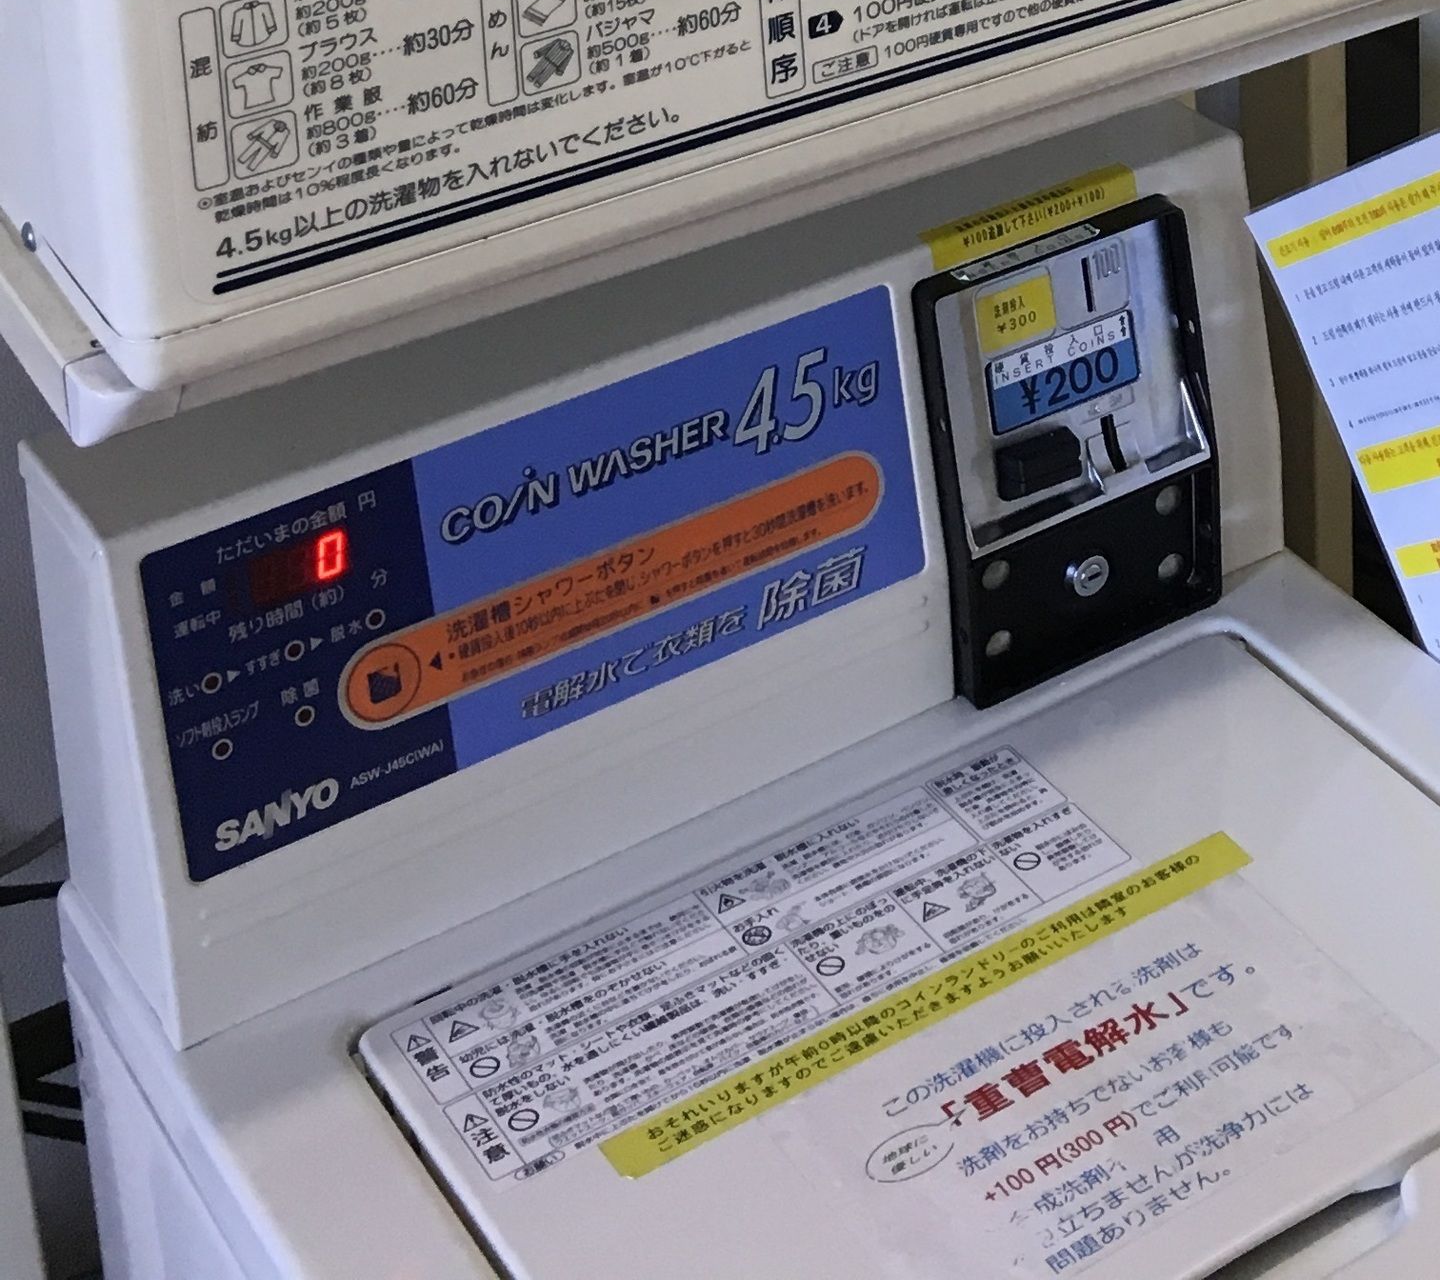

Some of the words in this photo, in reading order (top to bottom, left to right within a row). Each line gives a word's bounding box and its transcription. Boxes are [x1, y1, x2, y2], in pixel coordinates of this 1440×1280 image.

[403, 19, 474, 56] 約30分
[587, 9, 655, 41] パジャマ
[678, 1, 741, 36] 約60分
[816, 16, 831, 33] 4
[299, 27, 377, 62] ブラウス
[821, 52, 871, 78] ご注意
[407, 77, 479, 115] 約60分
[997, 310, 1037, 334] ¥300
[994, 352, 1056, 384] INSERT
[1067, 330, 1115, 358] COINS
[1022, 345, 1120, 416] ¥200
[570, 411, 730, 497] WASHER
[833, 360, 878, 405] kg
[216, 501, 348, 565] ただいまの金額
[358, 490, 378, 512] 円
[316, 530, 344, 580] 0
[370, 567, 389, 589] 分
[446, 547, 655, 641] 洗濯槽シャワーボタン
[173, 610, 222, 640] 運転中
[521, 606, 746, 719] 電解水で衣類を
[758, 547, 866, 631] 除菌
[168, 679, 200, 708] 洗い
[214, 777, 339, 853] SANYO
[942, 963, 1256, 1129] 「重曹電解水」です。
[1046, 1163, 1232, 1274] 問題ありません。
